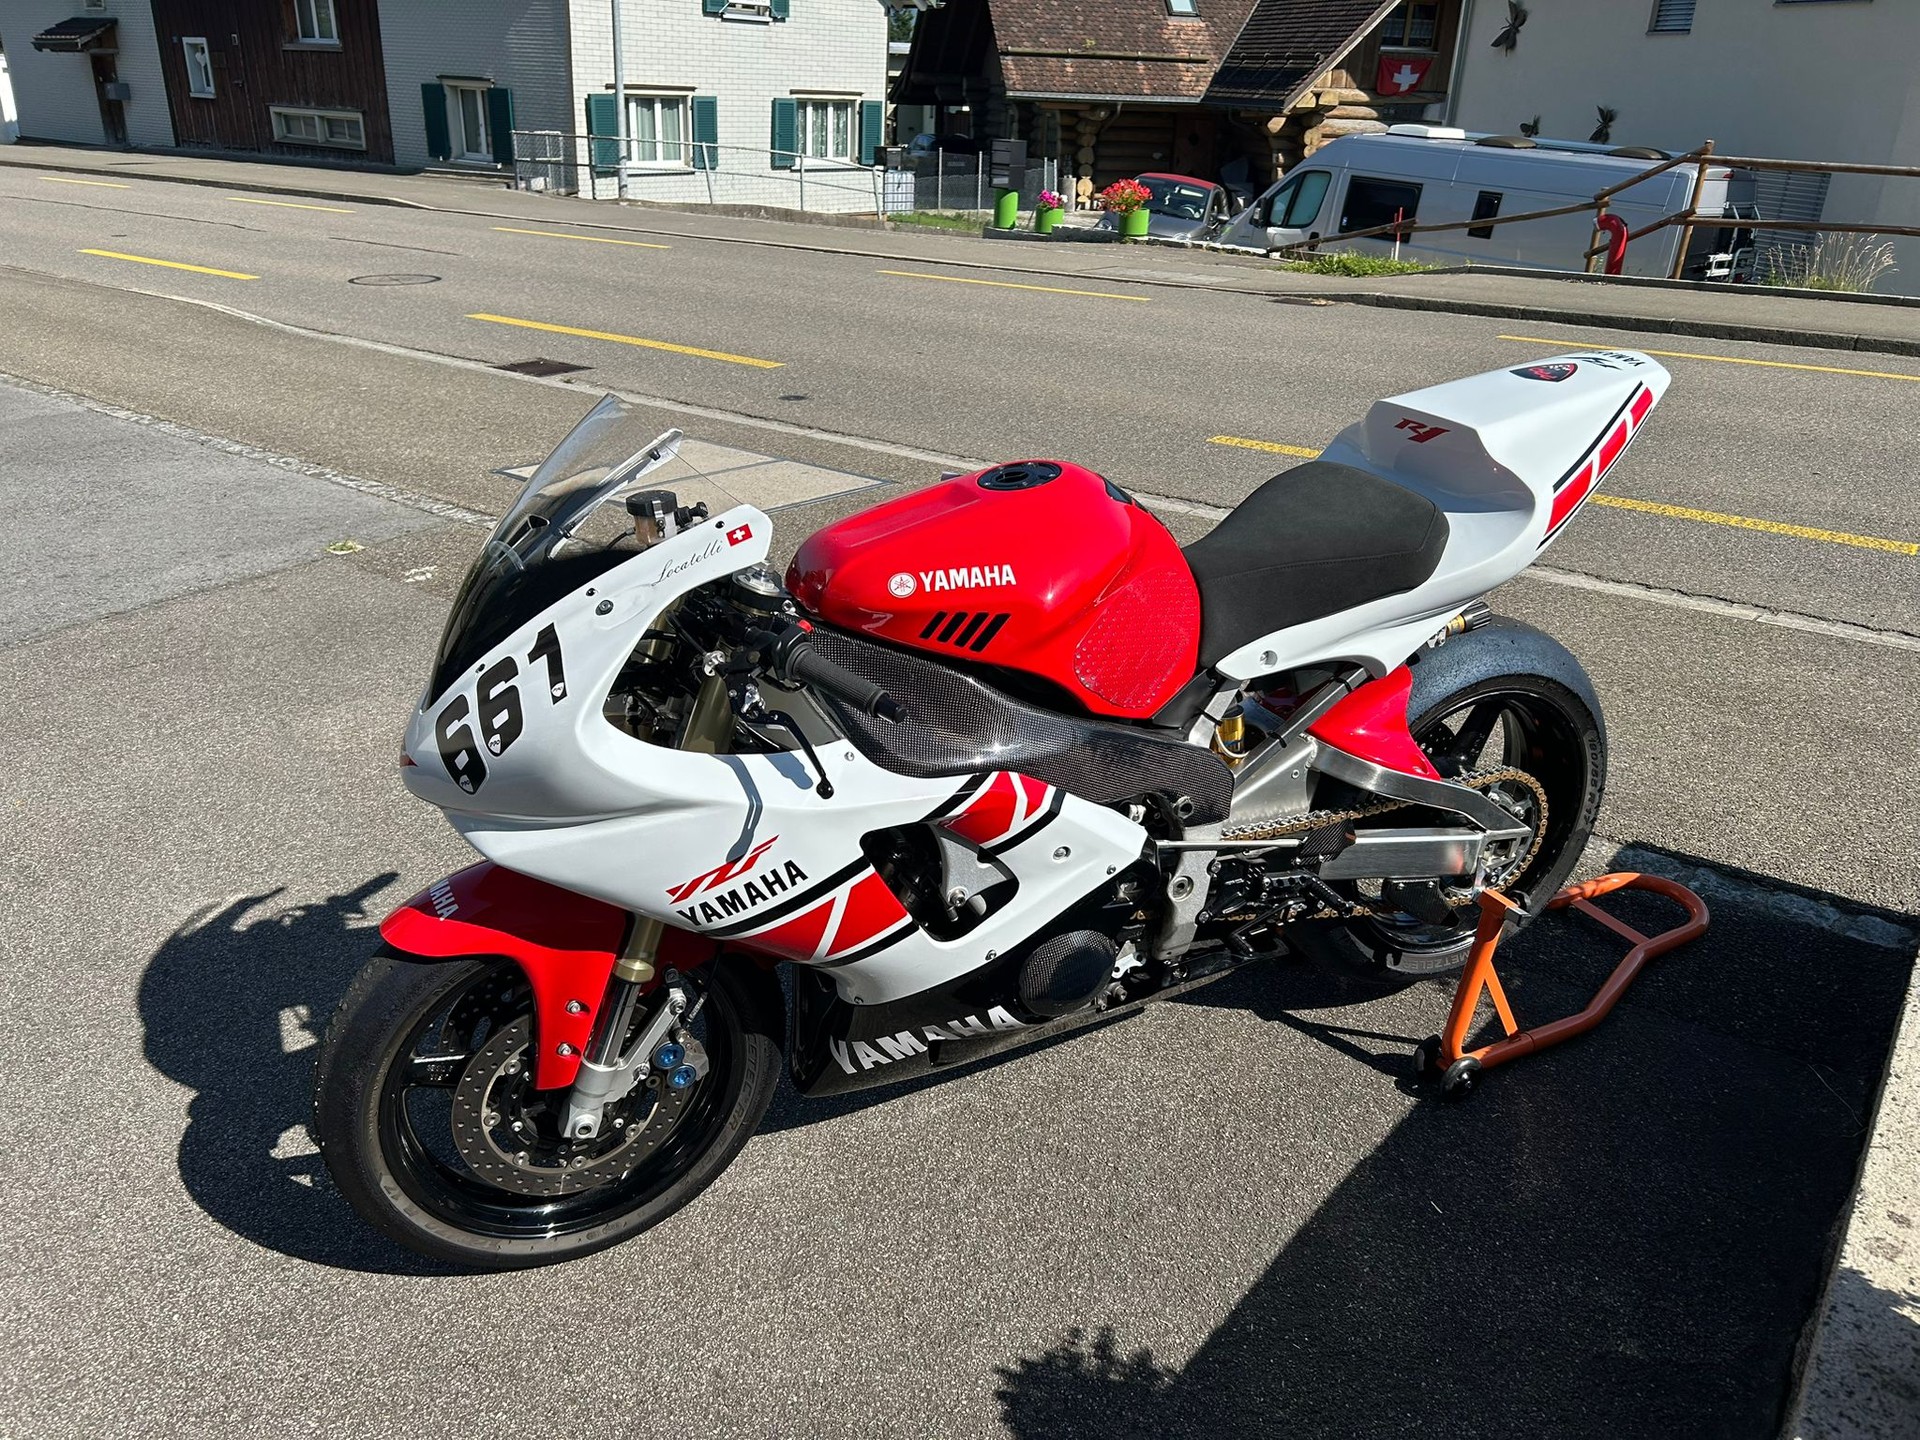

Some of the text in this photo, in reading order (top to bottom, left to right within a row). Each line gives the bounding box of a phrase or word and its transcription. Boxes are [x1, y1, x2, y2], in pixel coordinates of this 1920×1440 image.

[651, 540, 723, 587] Locatelli
[918, 564, 1017, 592] YAMAHA
[436, 622, 568, 796] 661
[675, 860, 809, 927] YAMAHA
[829, 1005, 1026, 1075] YAMAHA
